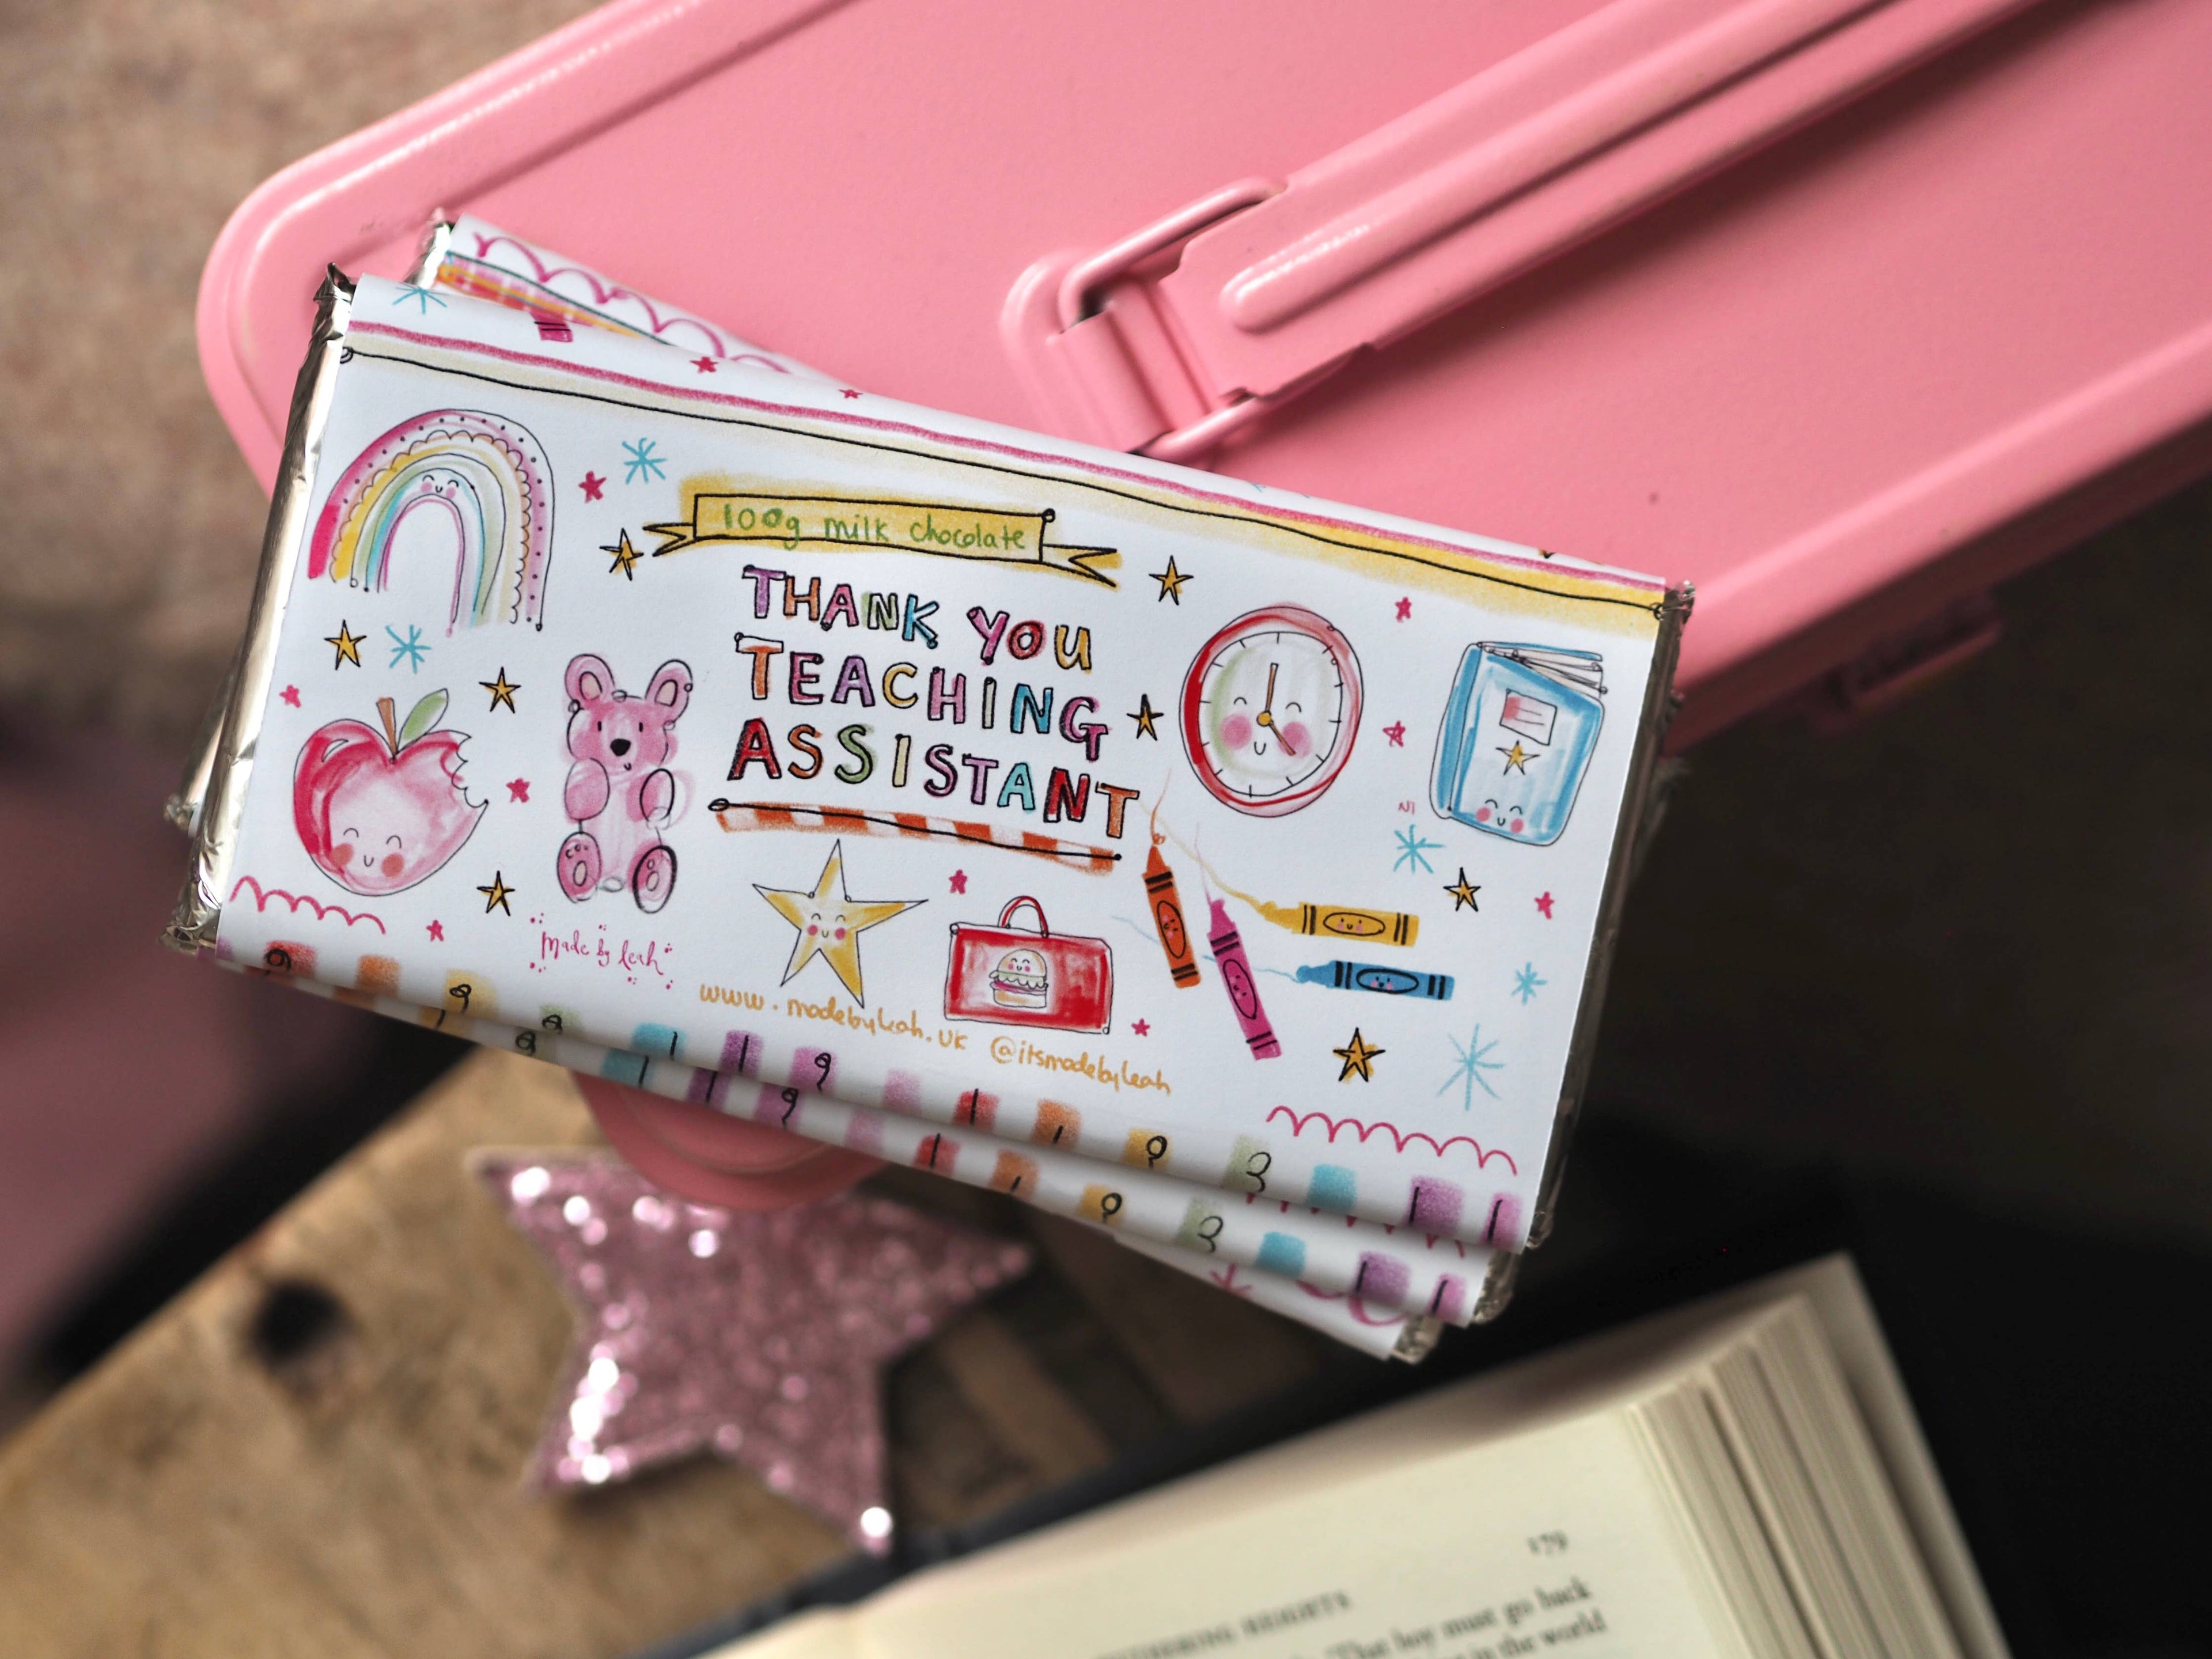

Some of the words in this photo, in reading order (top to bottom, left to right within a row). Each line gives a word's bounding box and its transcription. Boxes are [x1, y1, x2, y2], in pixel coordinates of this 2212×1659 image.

[723, 503, 801, 550] 100g
[824, 515, 889, 543] milk
[909, 512, 1028, 551] chocolate
[741, 565, 940, 649] THANK
[967, 606, 1093, 673] YOU
[734, 631, 1109, 762] TEACHING
[727, 718, 1140, 839] ASSISTANT
[596, 938, 610, 967] by
